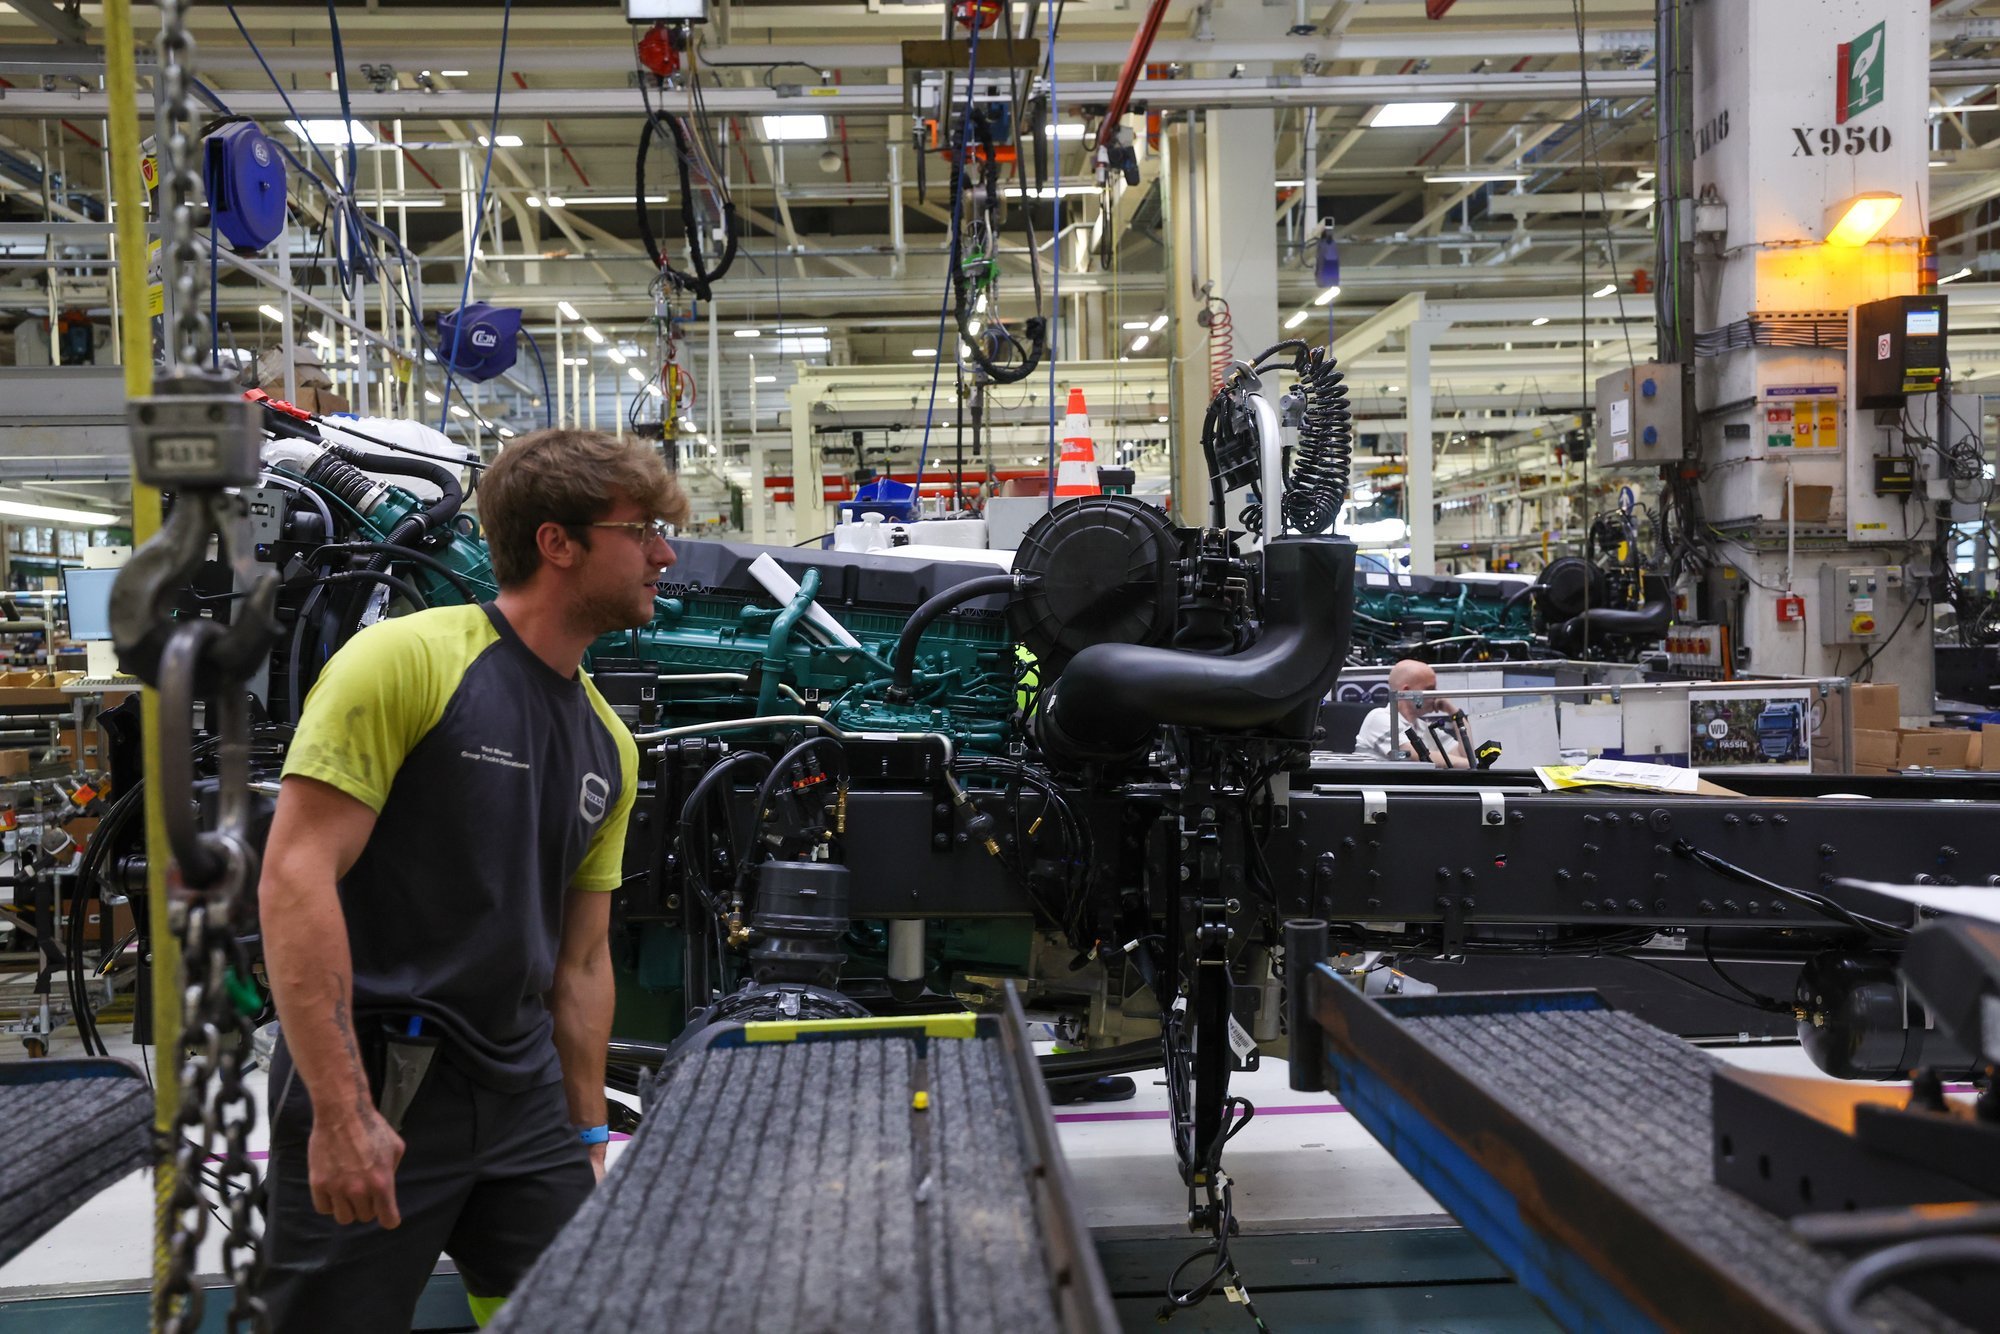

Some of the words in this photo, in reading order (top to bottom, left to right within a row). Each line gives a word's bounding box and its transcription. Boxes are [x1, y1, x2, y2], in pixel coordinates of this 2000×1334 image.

[1791, 125, 1892, 157] X950
[471, 330, 497, 347] CEJN
[660, 646, 755, 667] VOLVO
[1719, 740, 1749, 749] PASSIE
